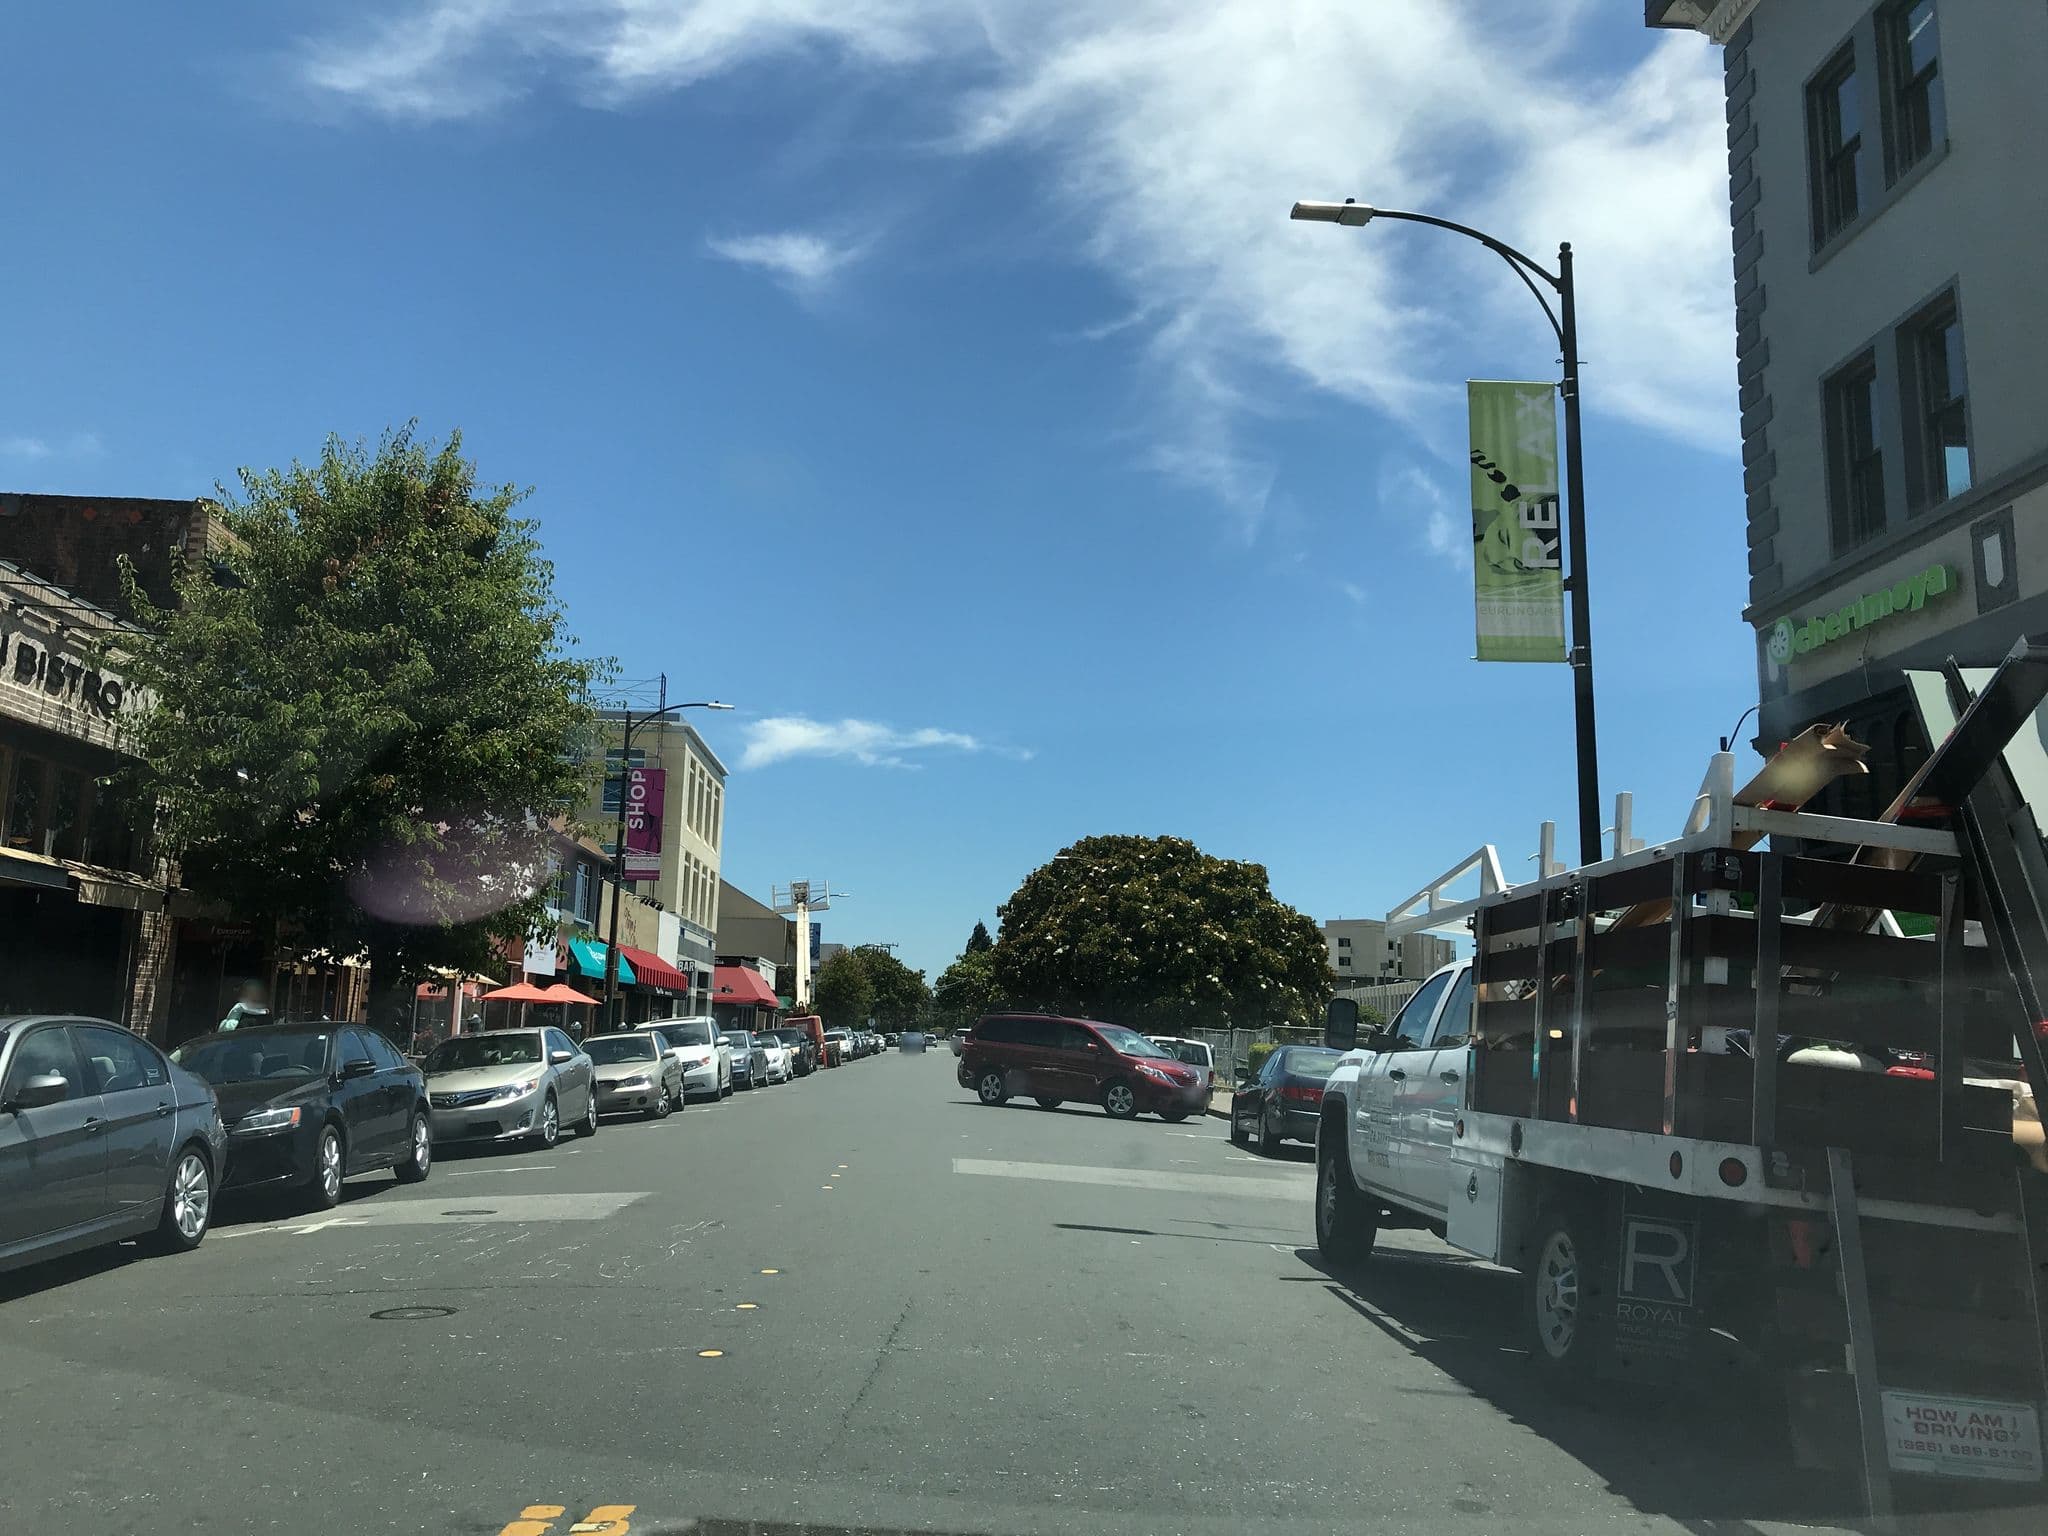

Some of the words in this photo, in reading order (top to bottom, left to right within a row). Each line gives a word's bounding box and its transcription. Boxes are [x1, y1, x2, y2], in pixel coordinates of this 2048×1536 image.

[1515, 388, 1560, 569] RELAX
[1794, 564, 1951, 654] cherimoya
[14, 641, 124, 719] BISTRO
[628, 769, 648, 830] SHOP
[678, 960, 695, 972] BAR
[1623, 1221, 1688, 1300] R
[1616, 1303, 1690, 1327] ROYAL
[1906, 1406, 1958, 1424] HOW
[1968, 1412, 2003, 1428] AM
[2012, 1416, 2018, 1430] I
[1913, 1421, 2021, 1443] DRIVING?
